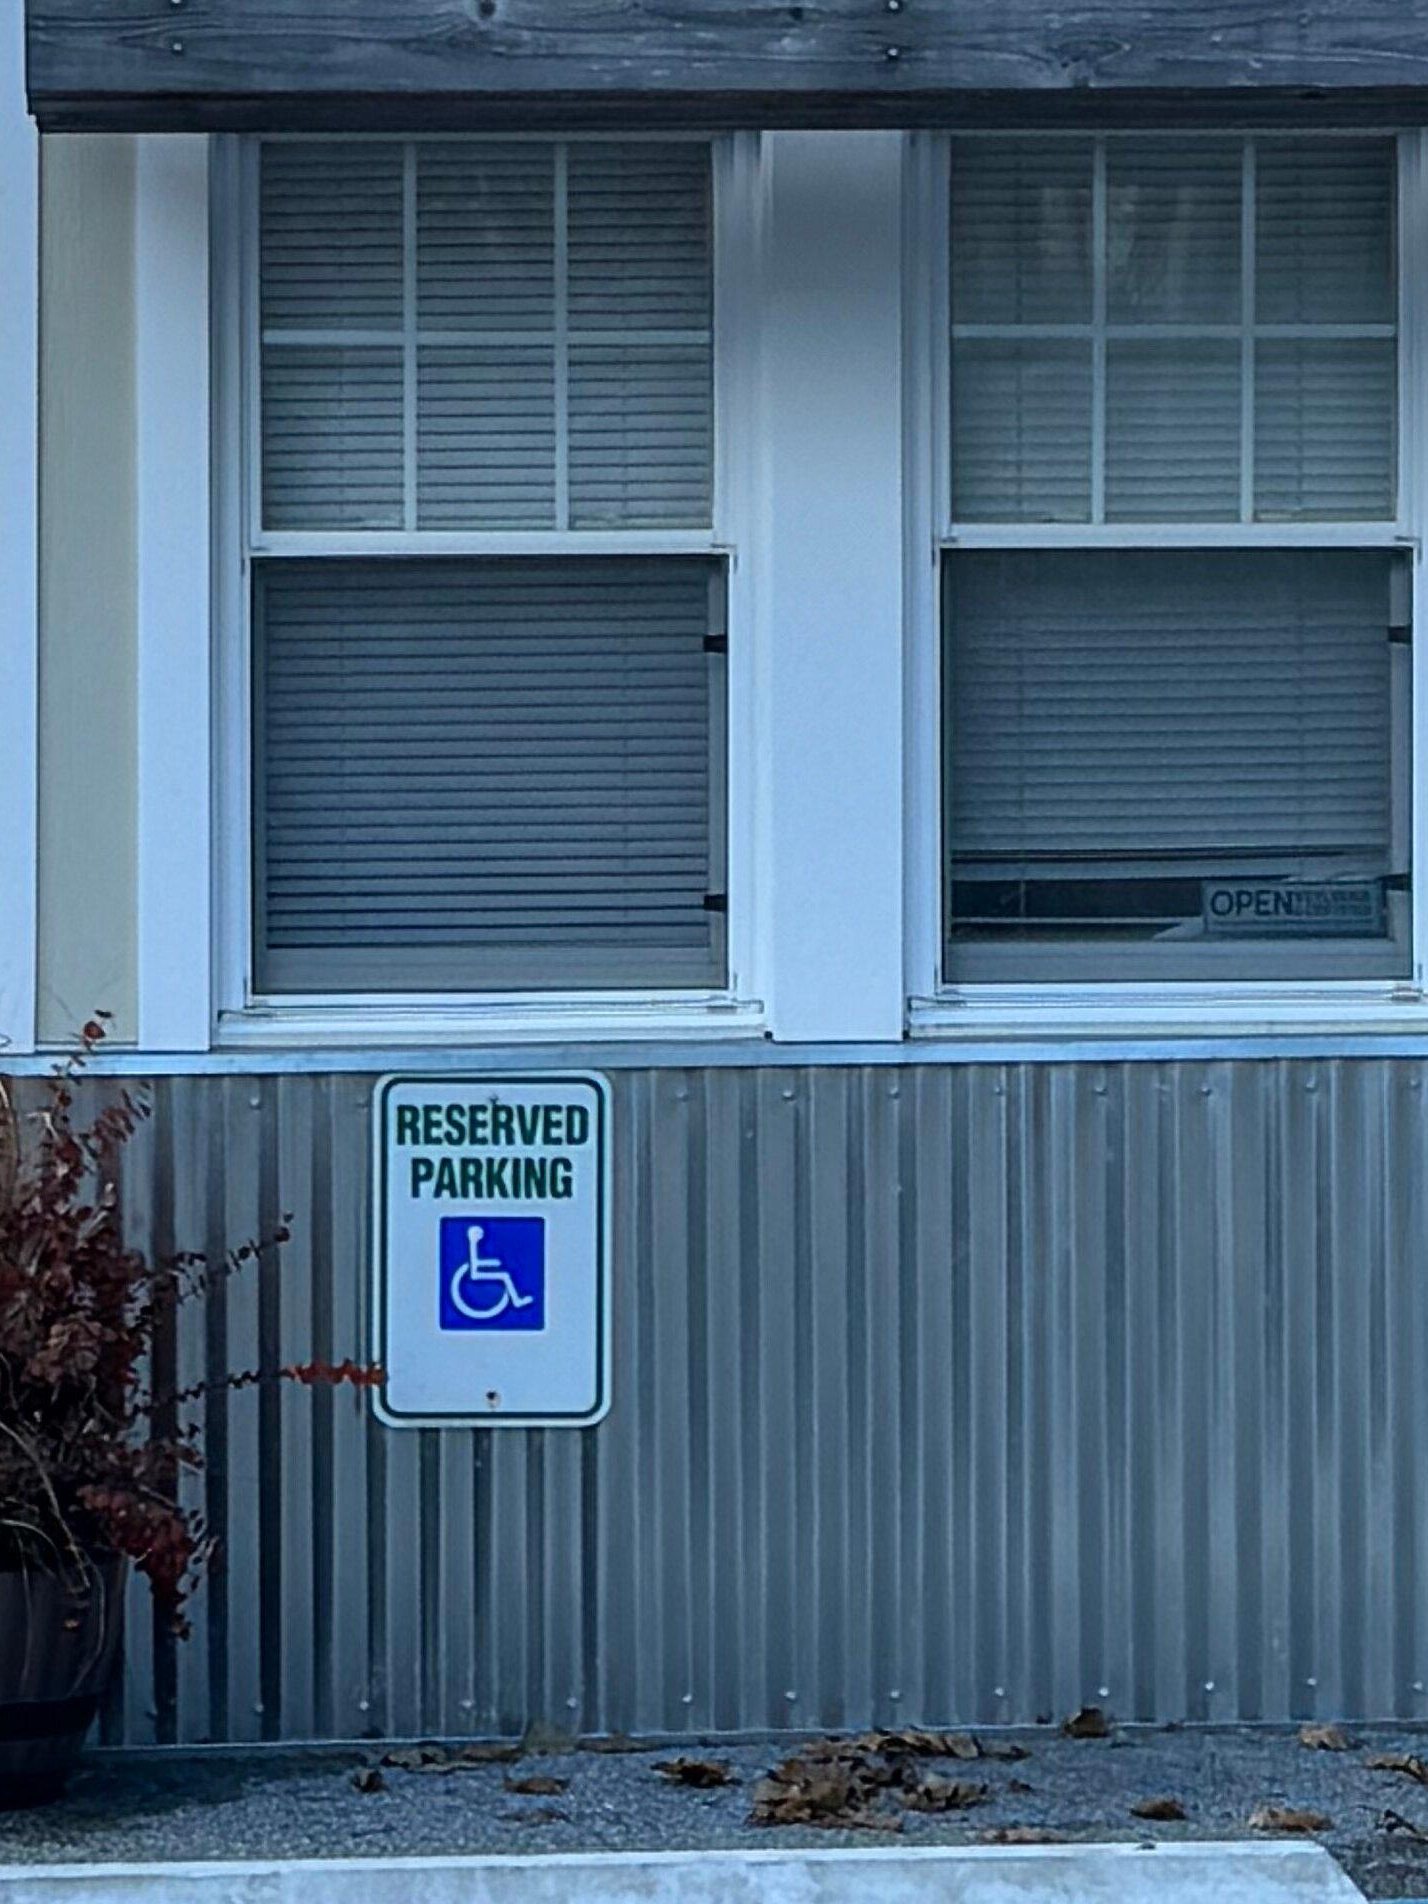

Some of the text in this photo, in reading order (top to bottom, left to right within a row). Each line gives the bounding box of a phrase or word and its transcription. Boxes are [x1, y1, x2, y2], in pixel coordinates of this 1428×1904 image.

[1211, 889, 1293, 916] OPEN
[396, 1104, 589, 1146] RESERVED
[410, 1158, 573, 1199] PARKING
